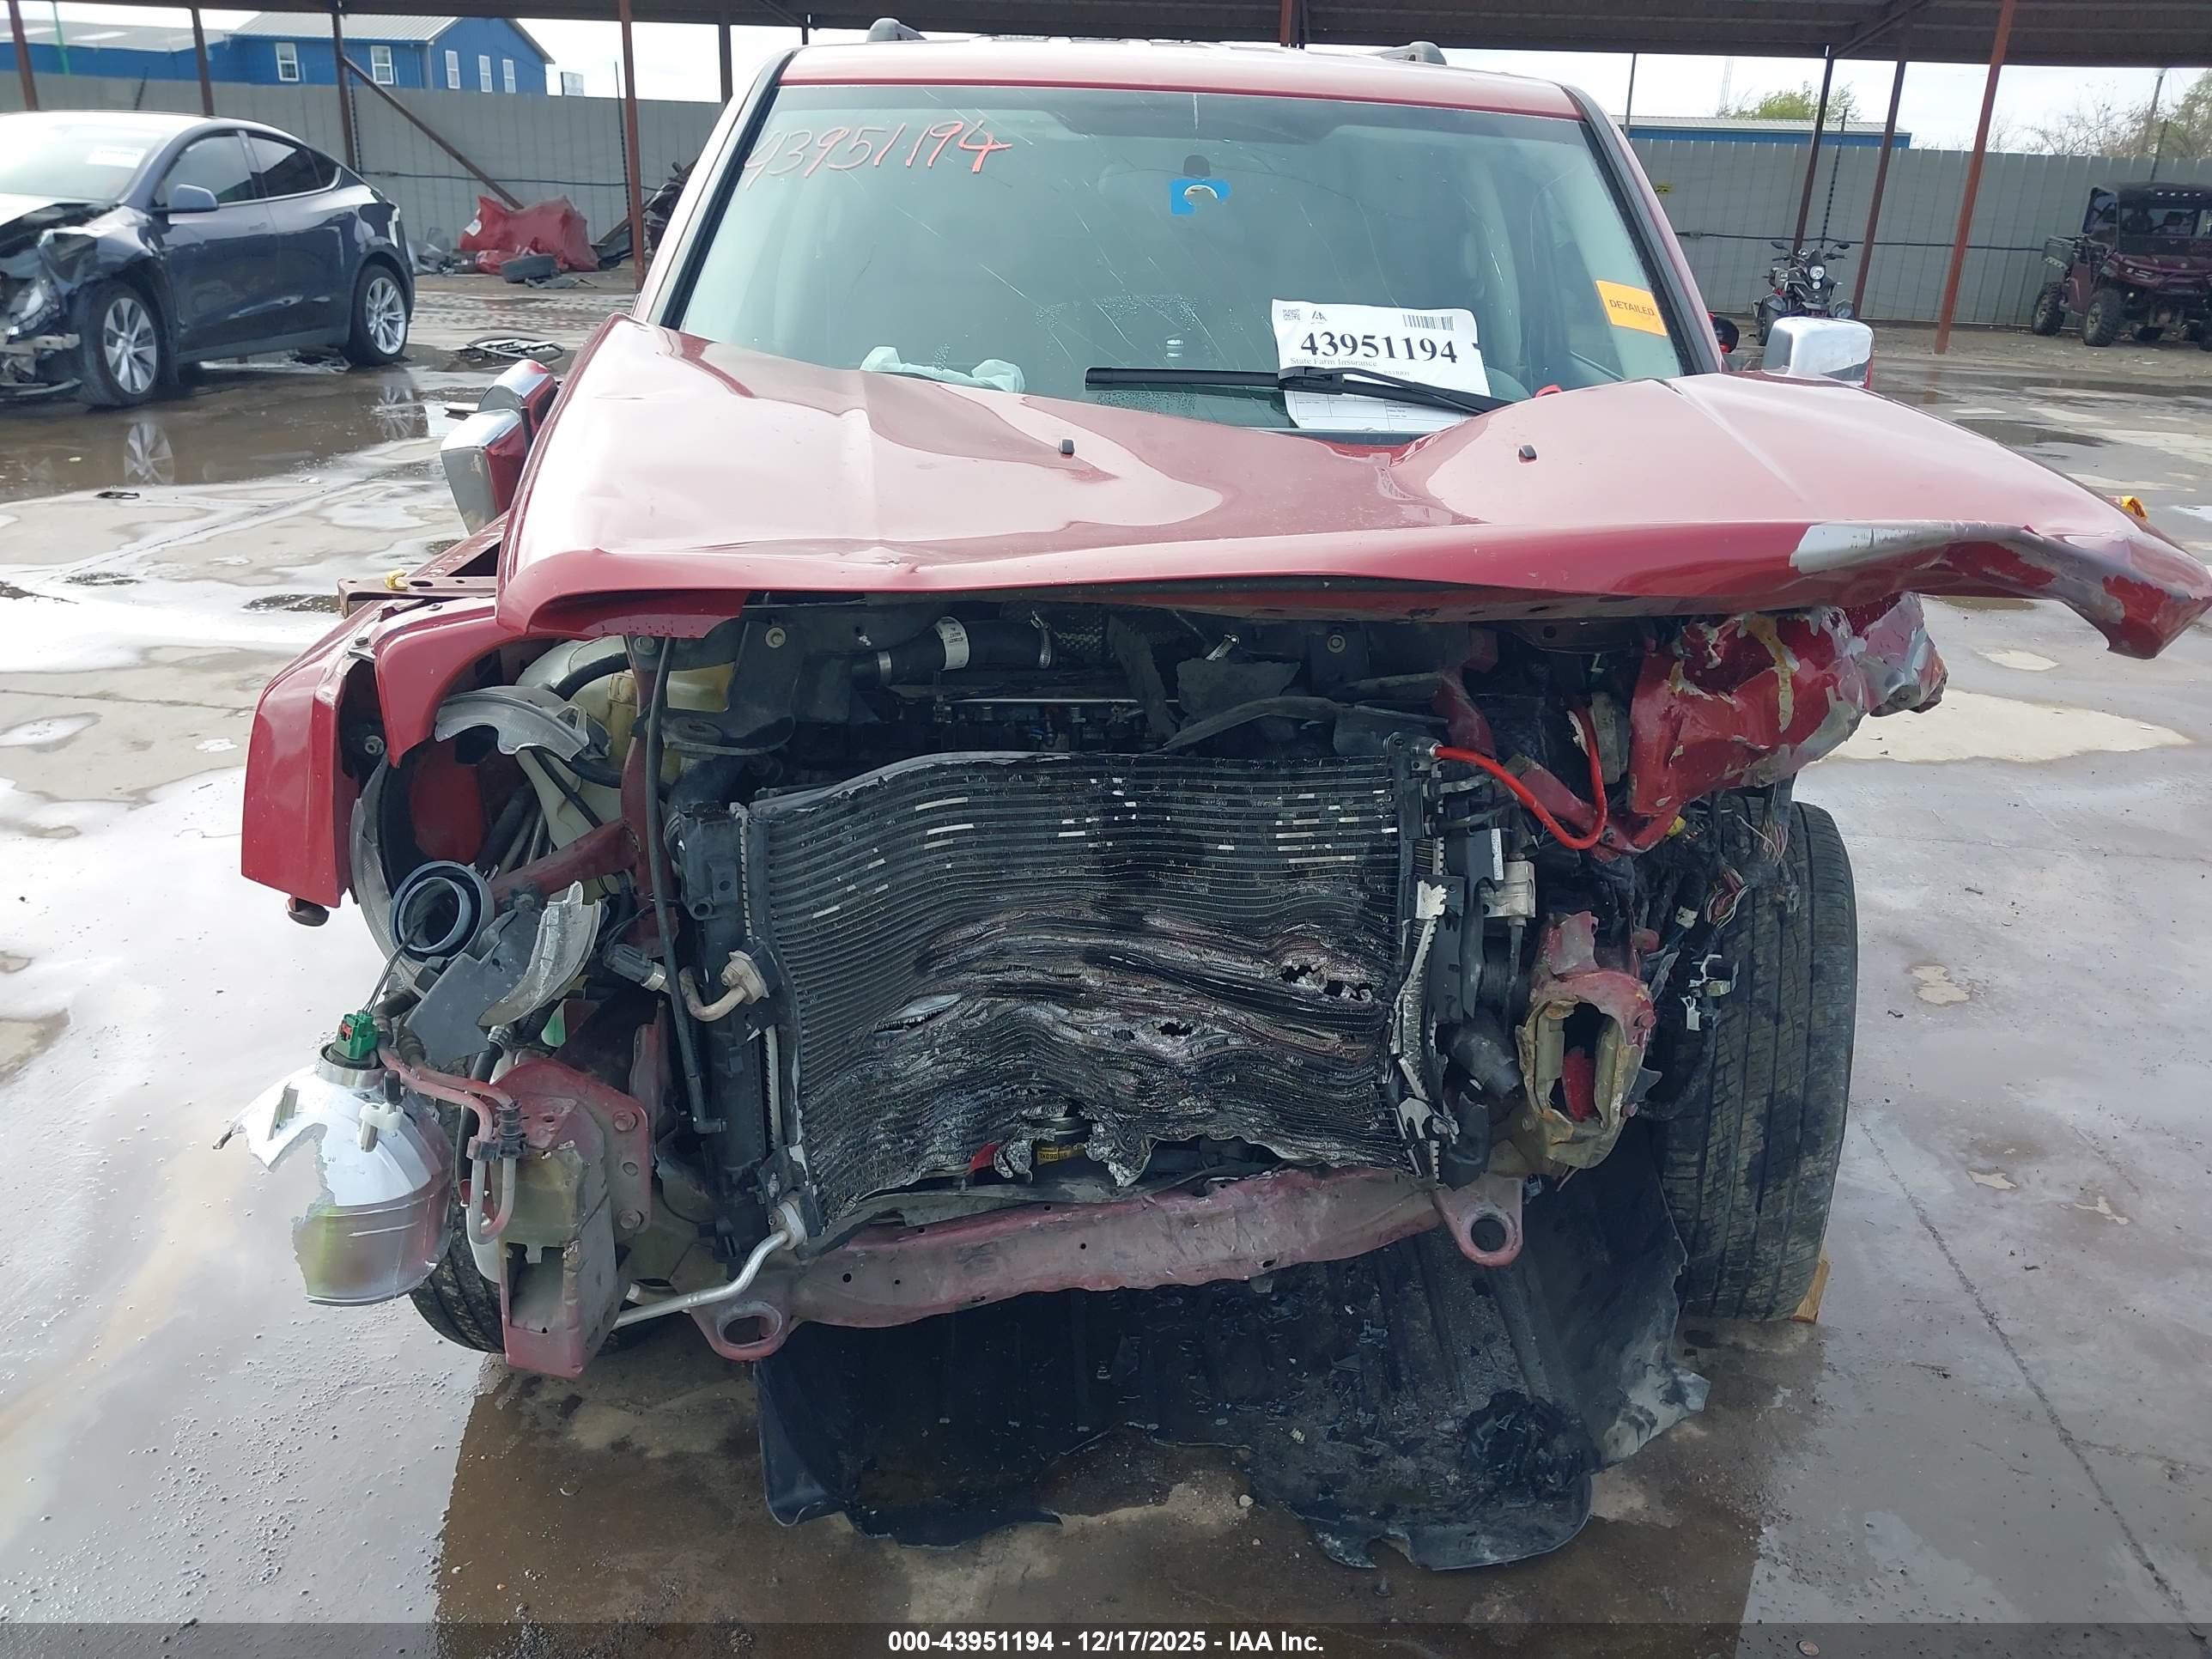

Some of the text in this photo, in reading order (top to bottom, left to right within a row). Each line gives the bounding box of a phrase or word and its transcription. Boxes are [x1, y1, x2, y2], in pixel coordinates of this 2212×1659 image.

[744, 118, 1013, 190] 43951194
[1609, 299, 1656, 317] DETAILED
[1300, 331, 1458, 364] 43951194
[1290, 356, 1377, 367] State Farm Insurance
